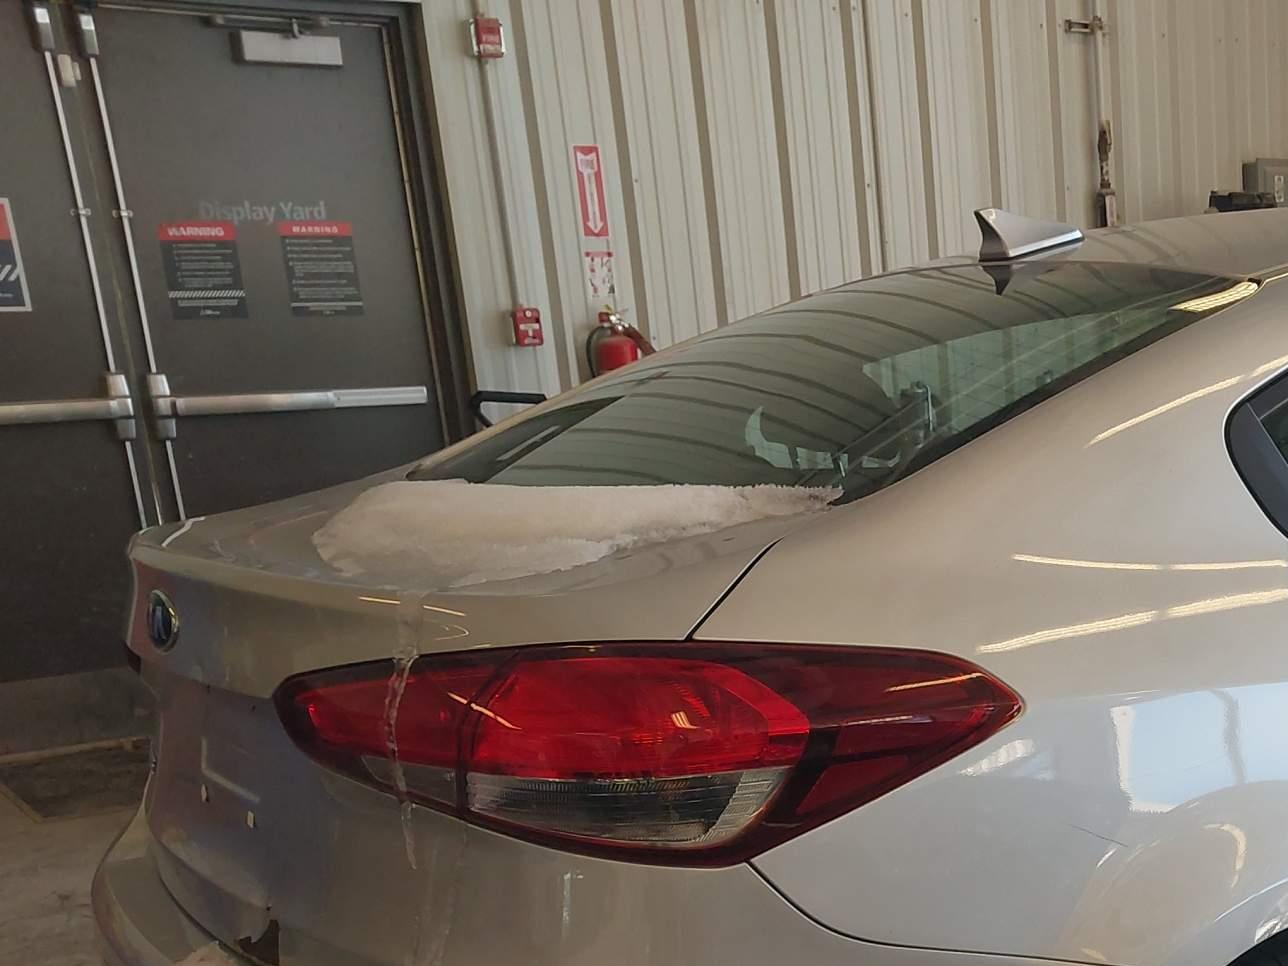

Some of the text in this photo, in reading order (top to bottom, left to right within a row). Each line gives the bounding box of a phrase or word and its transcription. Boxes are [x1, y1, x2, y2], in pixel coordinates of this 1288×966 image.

[199, 200, 326, 223] Display Yard
[168, 226, 224, 236] WARNING
[292, 225, 339, 233] WARNING
